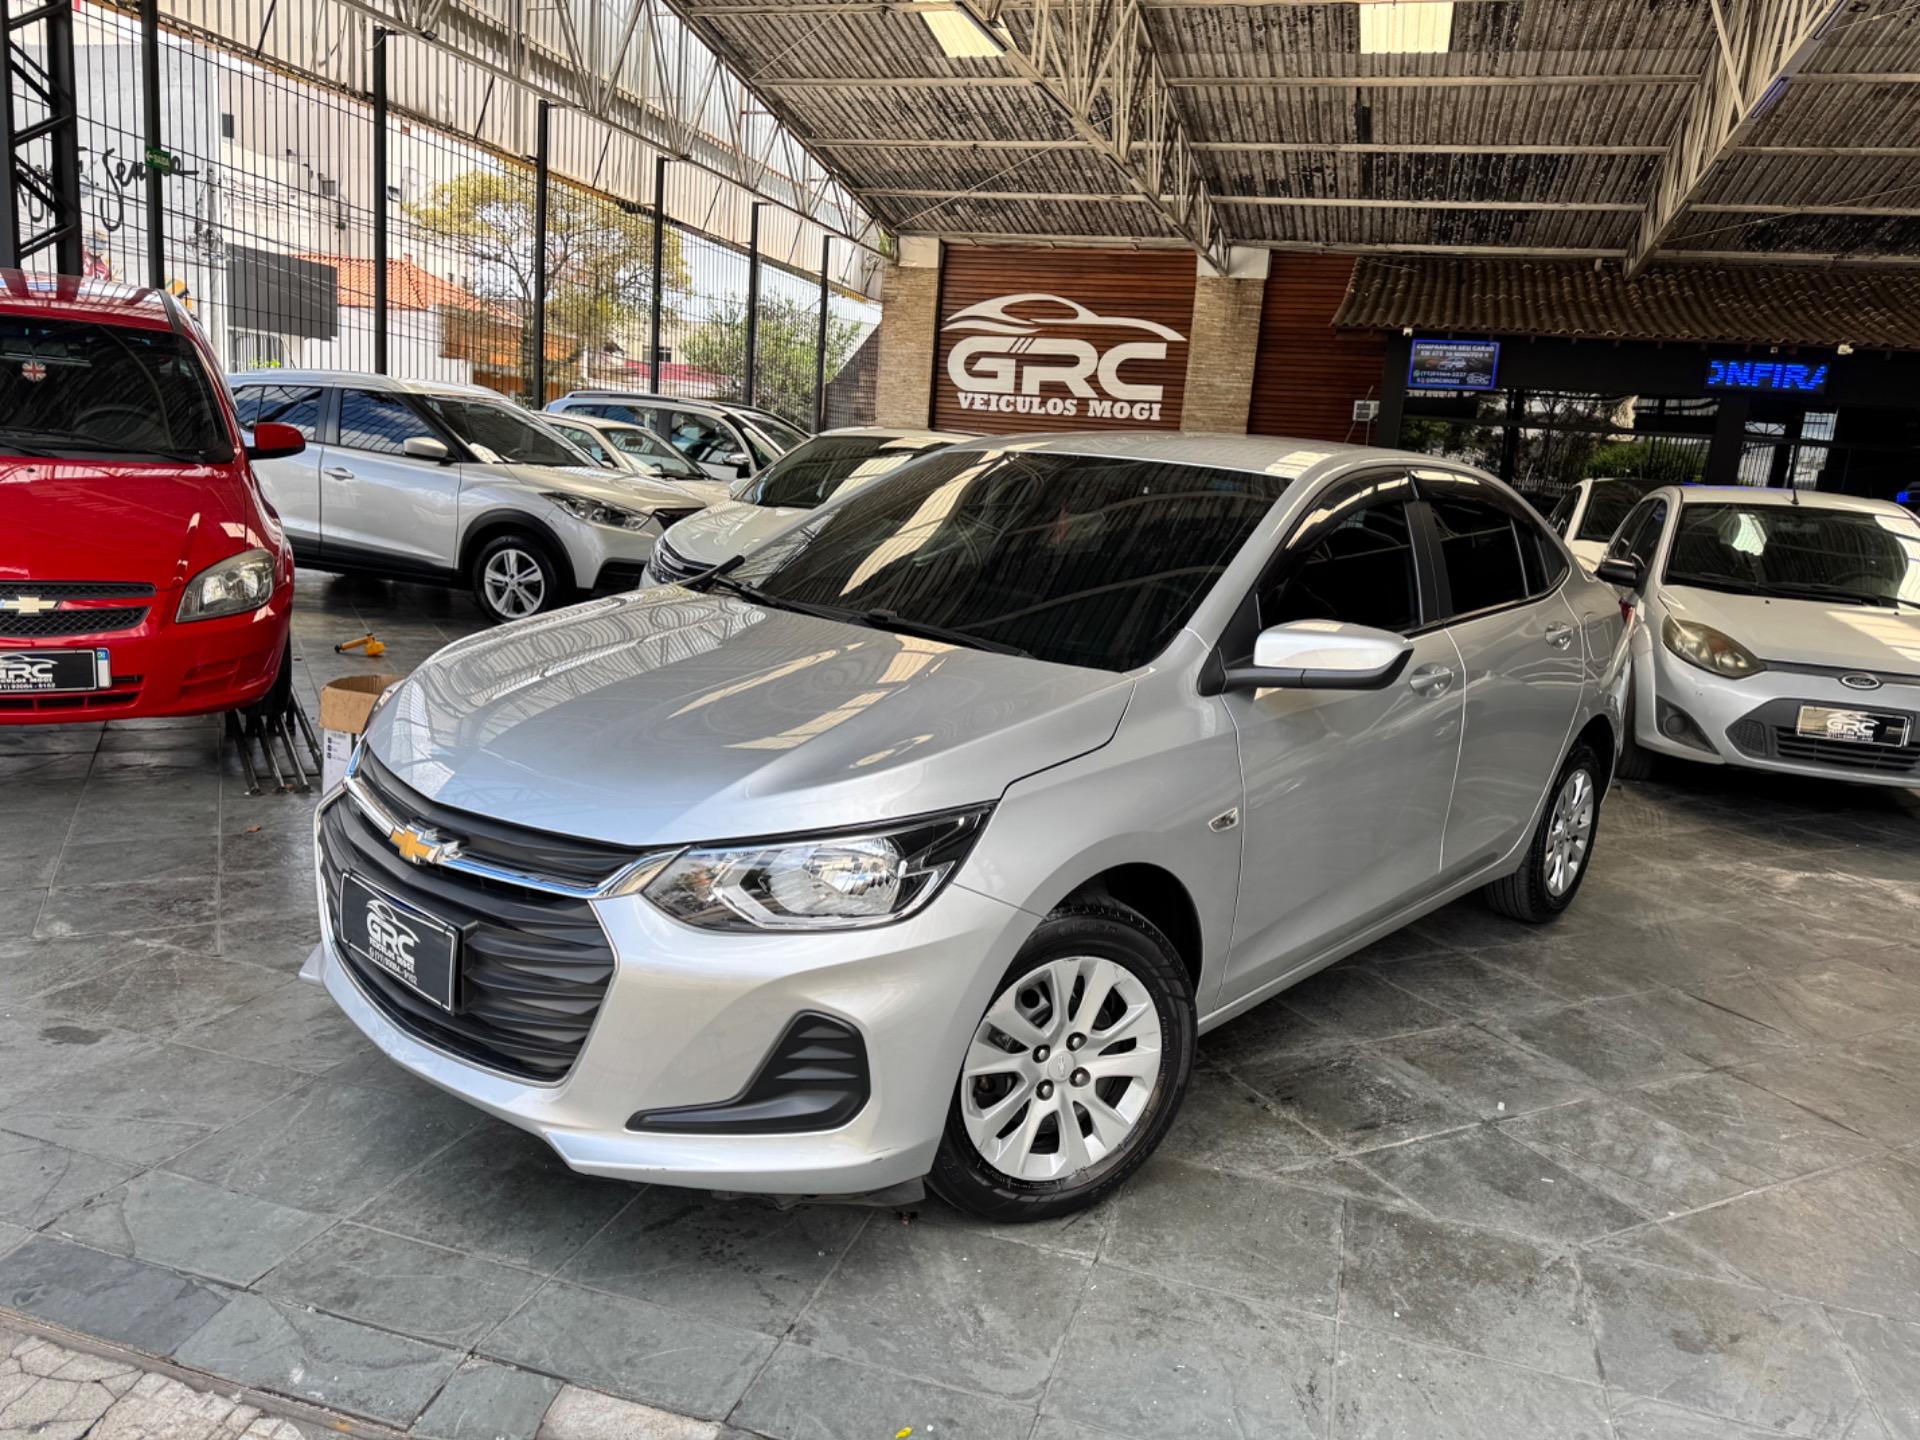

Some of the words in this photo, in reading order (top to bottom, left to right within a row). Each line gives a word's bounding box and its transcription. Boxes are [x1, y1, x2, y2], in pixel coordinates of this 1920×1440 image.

[947, 335, 1168, 401] GRC
[957, 392, 1077, 416] VEICULOS
[1087, 400, 1162, 420] MOGI
[1827, 719, 1876, 735] GRC
[366, 911, 415, 965] GRC
